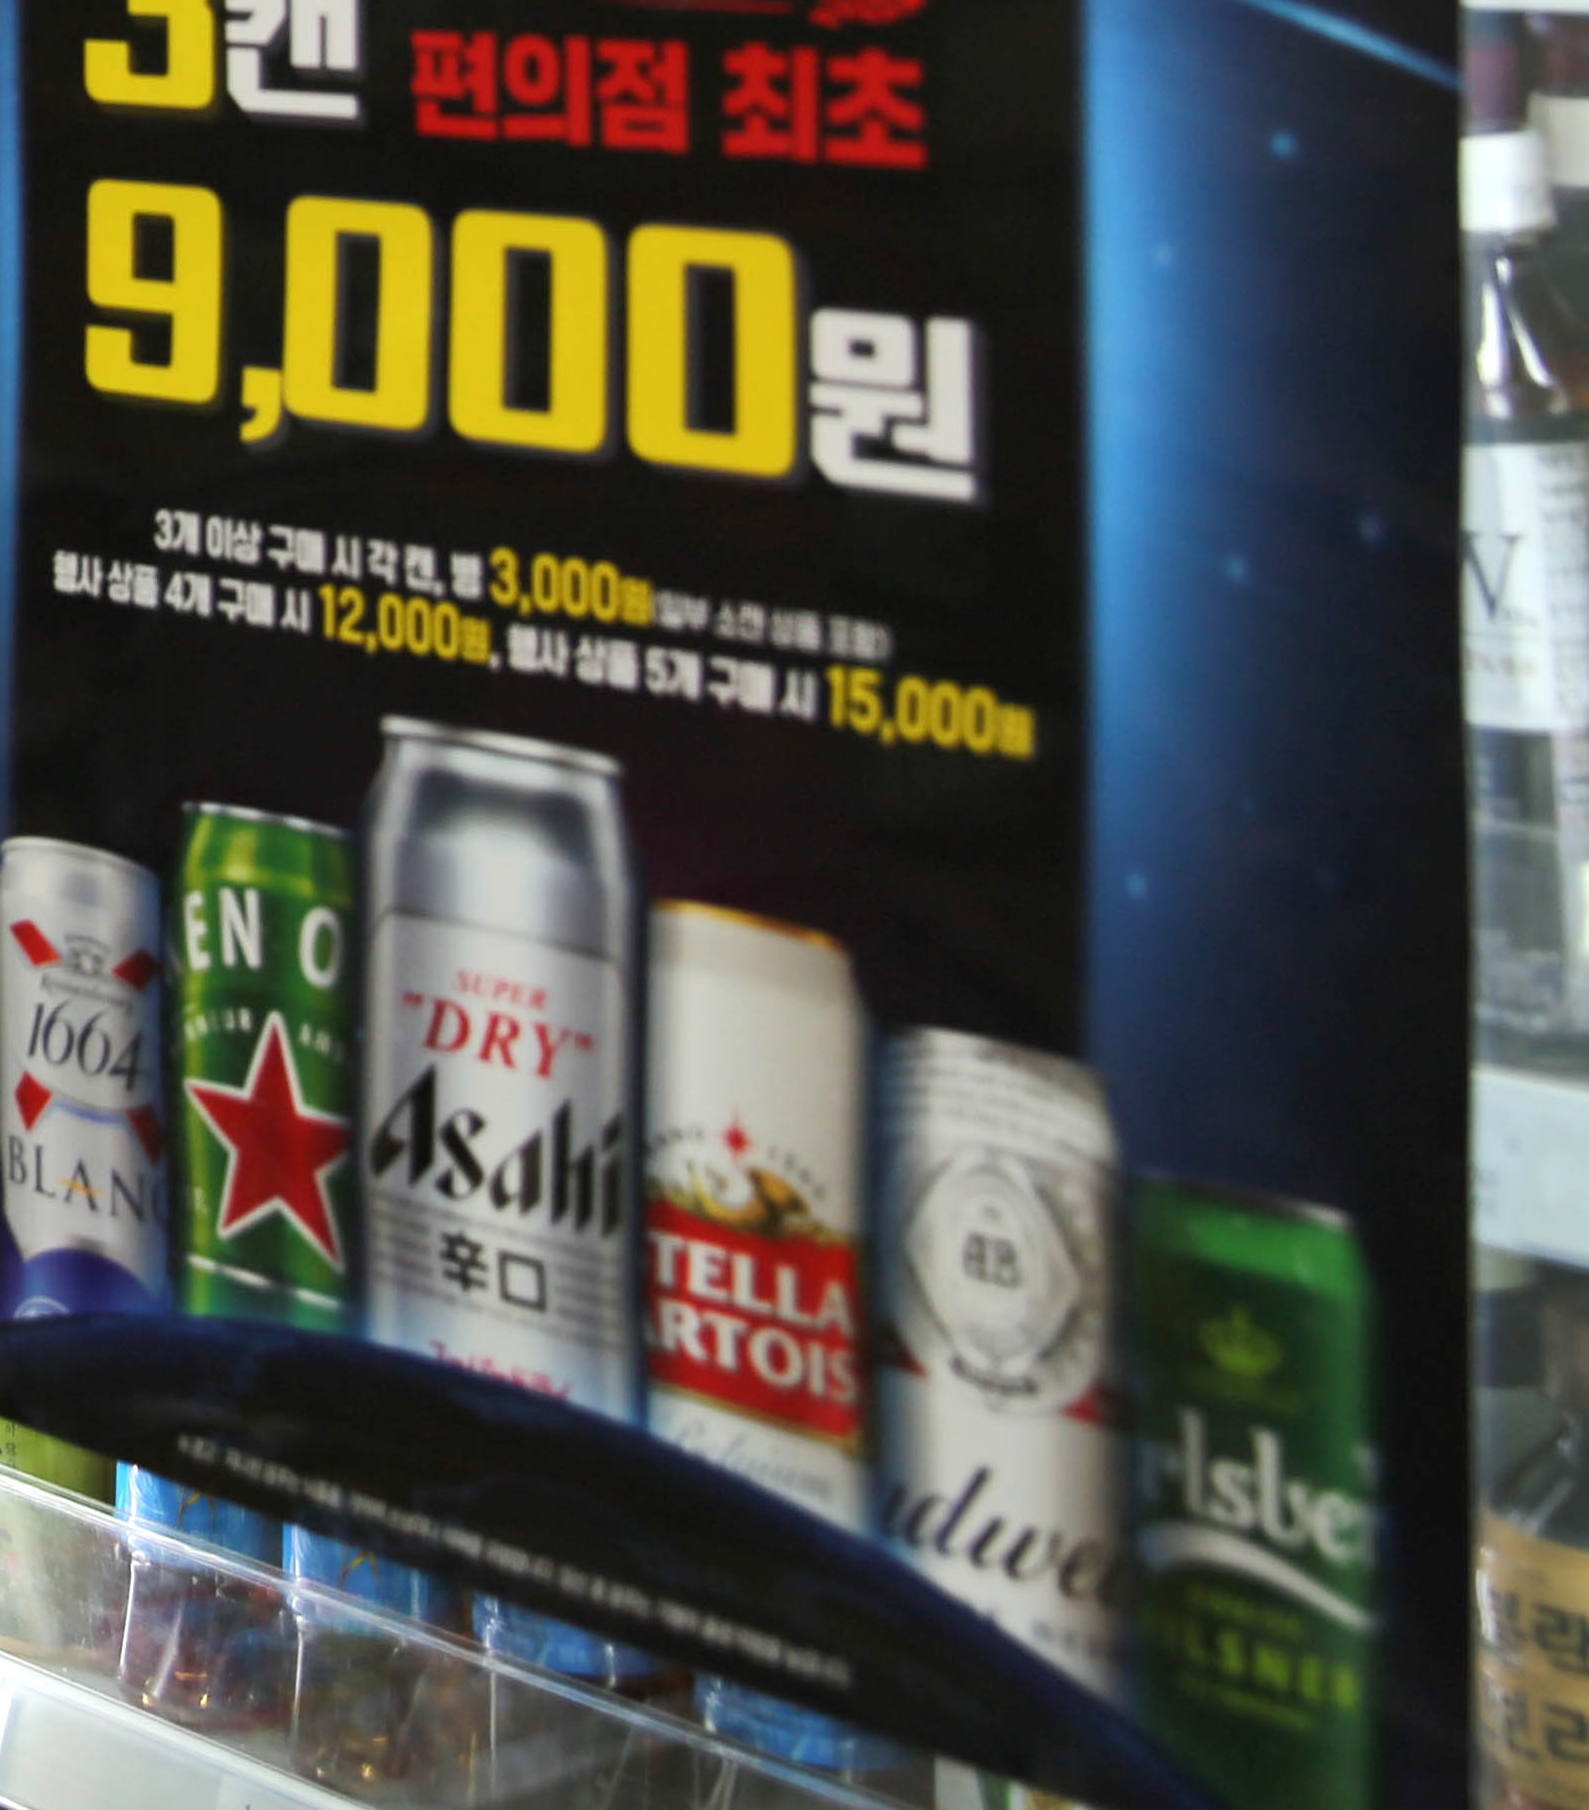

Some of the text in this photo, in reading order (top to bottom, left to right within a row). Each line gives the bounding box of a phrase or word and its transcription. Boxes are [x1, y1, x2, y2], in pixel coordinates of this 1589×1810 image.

[411, 28, 689, 154] 편의점
[719, 41, 927, 169] 최초
[84, 178, 977, 503] 9,000원
[153, 508, 201, 557] 3개
[206, 515, 262, 565] 이상
[267, 524, 326, 573] 구매
[331, 535, 361, 580] 시
[367, 538, 399, 584] 각
[53, 548, 103, 598] 행사
[107, 559, 159, 610] 상품
[164, 571, 212, 618] 4개
[217, 577, 275, 629] 구매
[280, 587, 312, 634] 시
[507, 623, 570, 678] 행사
[574, 633, 639, 691] 상품
[644, 646, 702, 701] 5개
[707, 655, 777, 717] 구매
[780, 669, 818, 723] 시
[826, 663, 1038, 763] 15,000원
[454, 967, 548, 1010] SUPER
[26, 1001, 146, 1093] 1664
[370, 1063, 627, 1238] Asahi
[438, 1231, 550, 1315] 辛口
